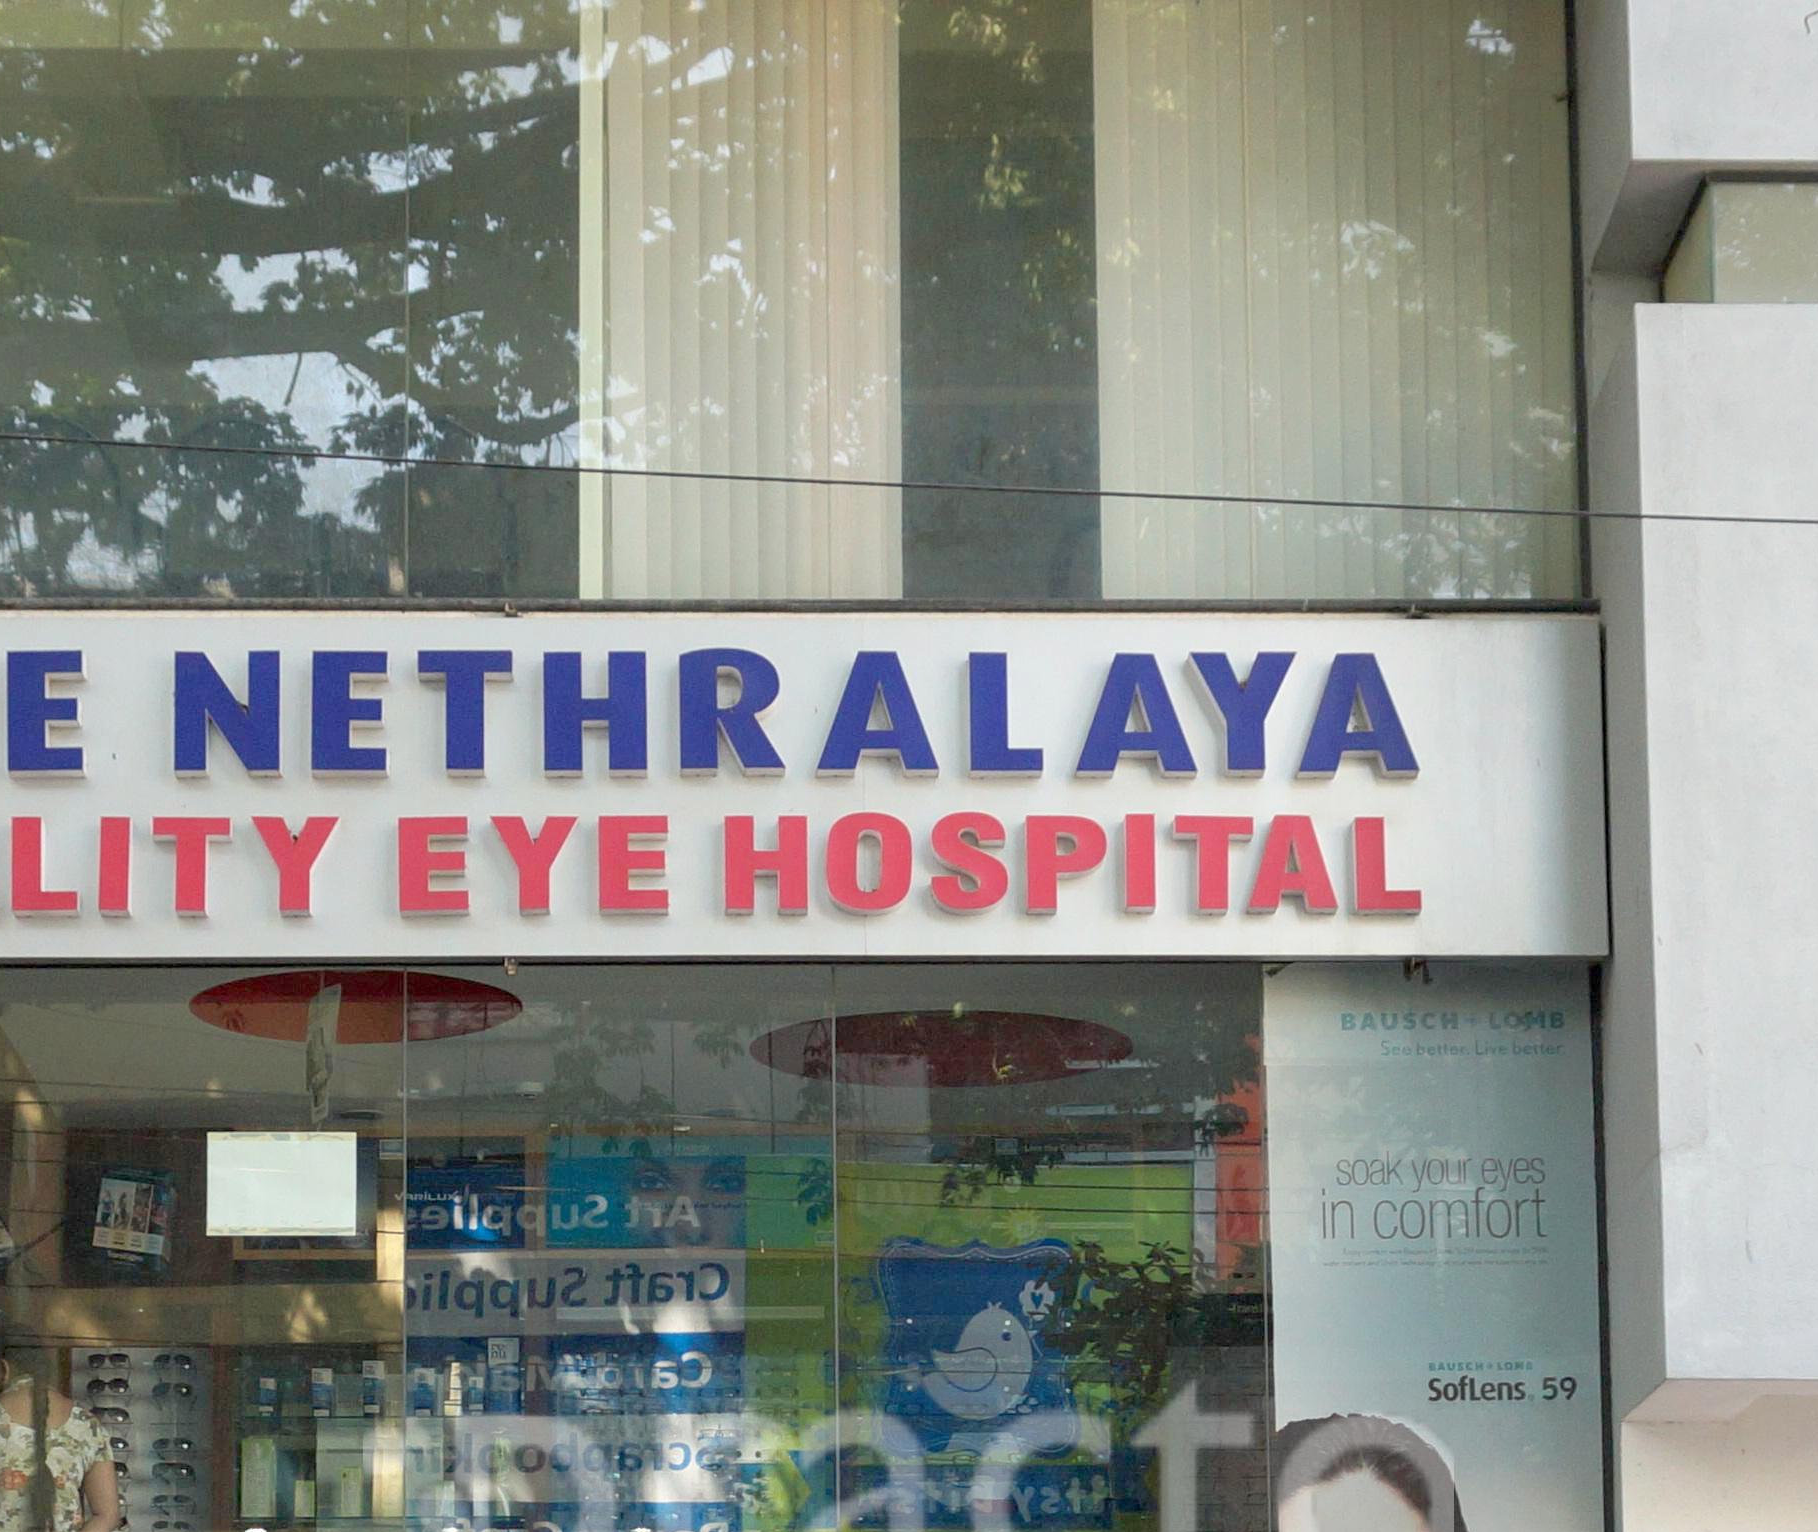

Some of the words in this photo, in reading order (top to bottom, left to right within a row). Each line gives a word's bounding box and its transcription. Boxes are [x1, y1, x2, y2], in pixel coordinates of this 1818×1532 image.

[174, 646, 1421, 780] NETHRALAYA
[398, 814, 670, 918] EYE
[723, 810, 1424, 918] HOSPITAL
[1340, 1010, 1459, 1031] BAUSCH
[1380, 1040, 1413, 1056] See
[1474, 1041, 1508, 1055] Live
[1335, 1151, 1406, 1187] soak
[1411, 1156, 1473, 1193] your
[1480, 1156, 1547, 1193] eyes
[1321, 1187, 1355, 1240] in
[1372, 1186, 1548, 1240] comfort
[1428, 1362, 1484, 1372] BAUSCH
[1427, 1376, 1526, 1402] SofLens
[1542, 1376, 1578, 1401] 59
